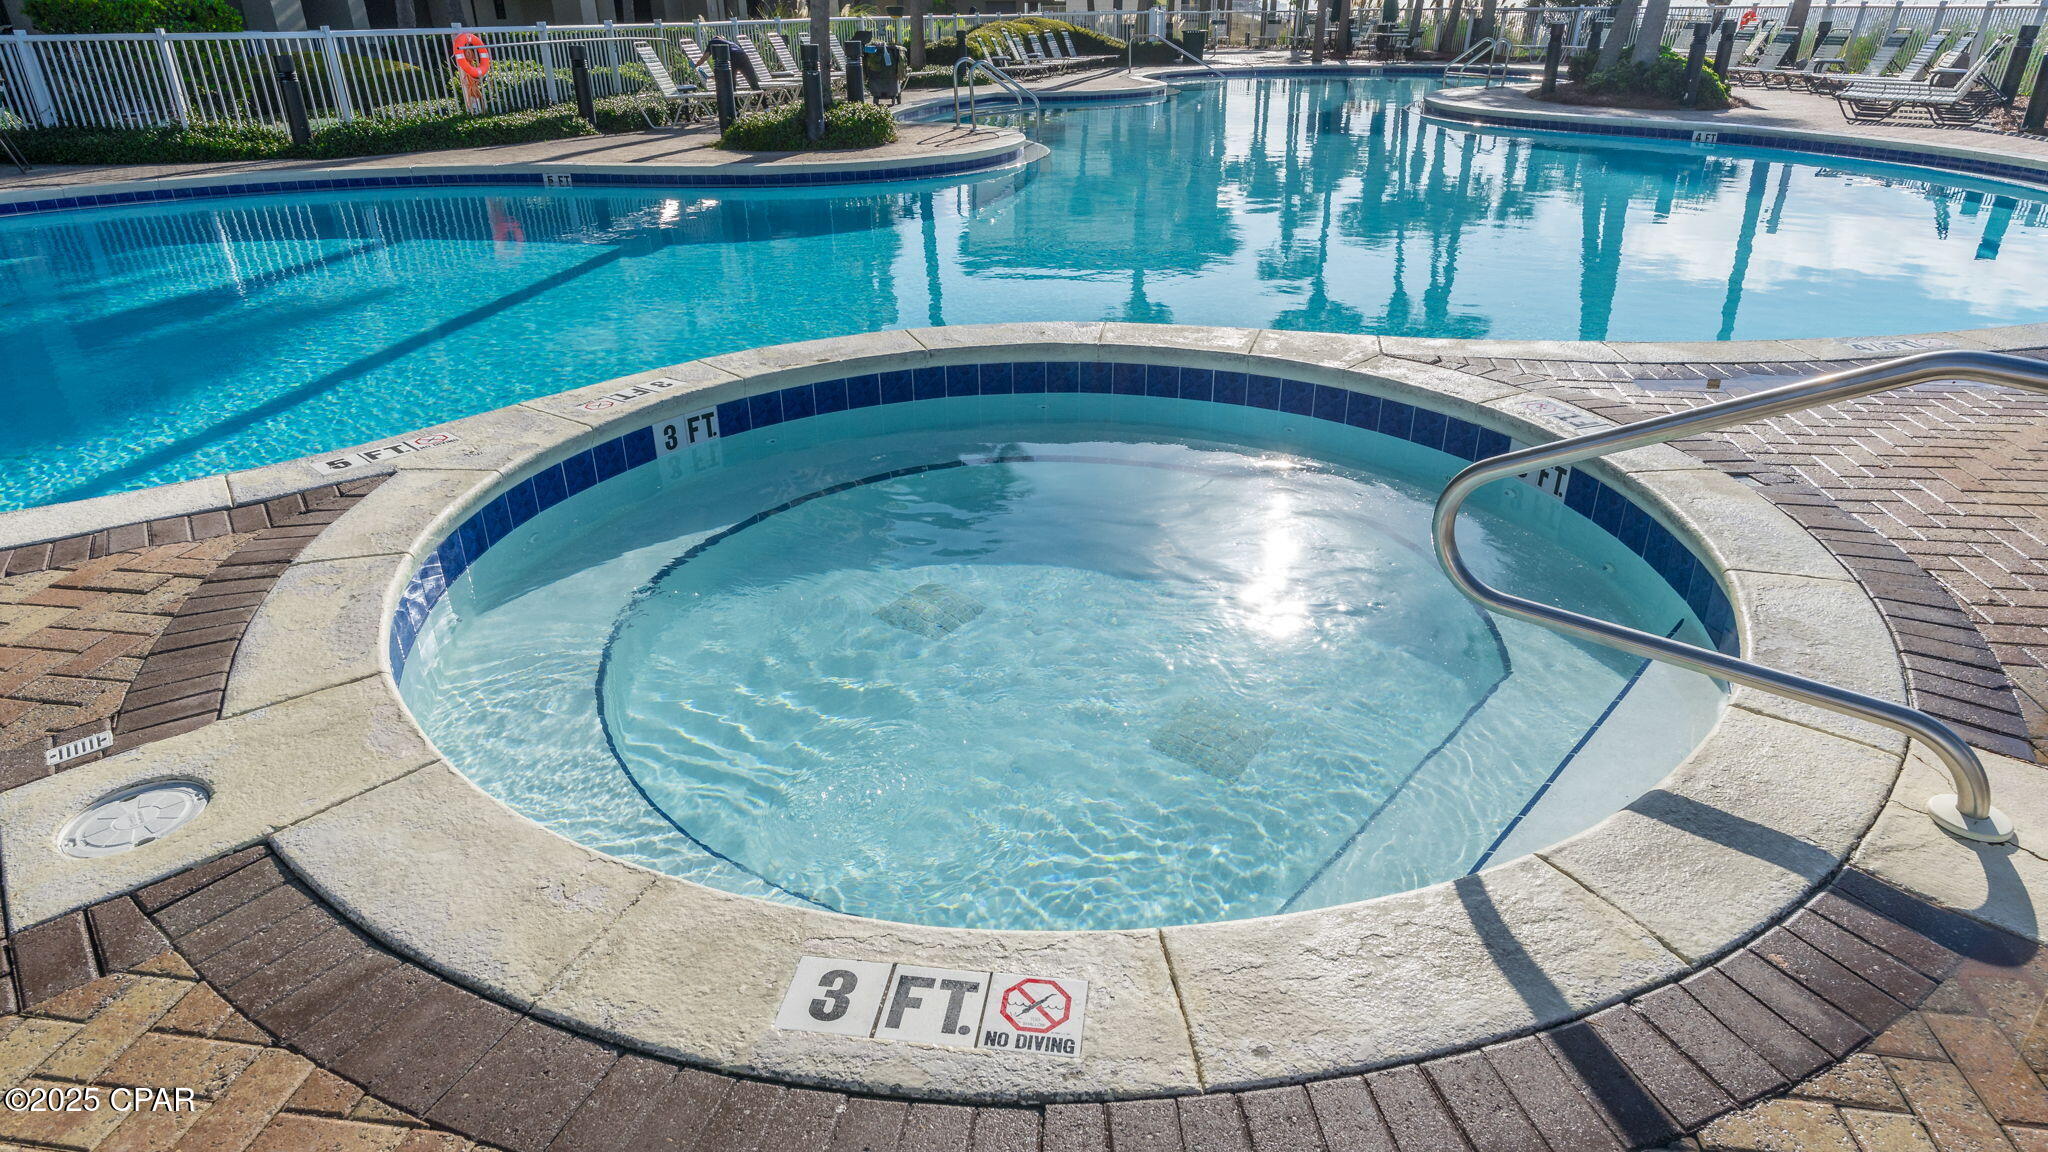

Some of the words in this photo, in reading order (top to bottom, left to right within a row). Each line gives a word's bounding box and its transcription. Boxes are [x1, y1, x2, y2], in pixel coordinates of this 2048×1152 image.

[663, 424, 678, 450] 3
[687, 411, 718, 443] FT.
[326, 458, 353, 470] 5
[363, 444, 411, 460] FT.
[808, 969, 858, 1022] 3
[884, 974, 981, 1035] FT.
[984, 1030, 1009, 1048] NO
[1015, 1033, 1076, 1054] DIVING
